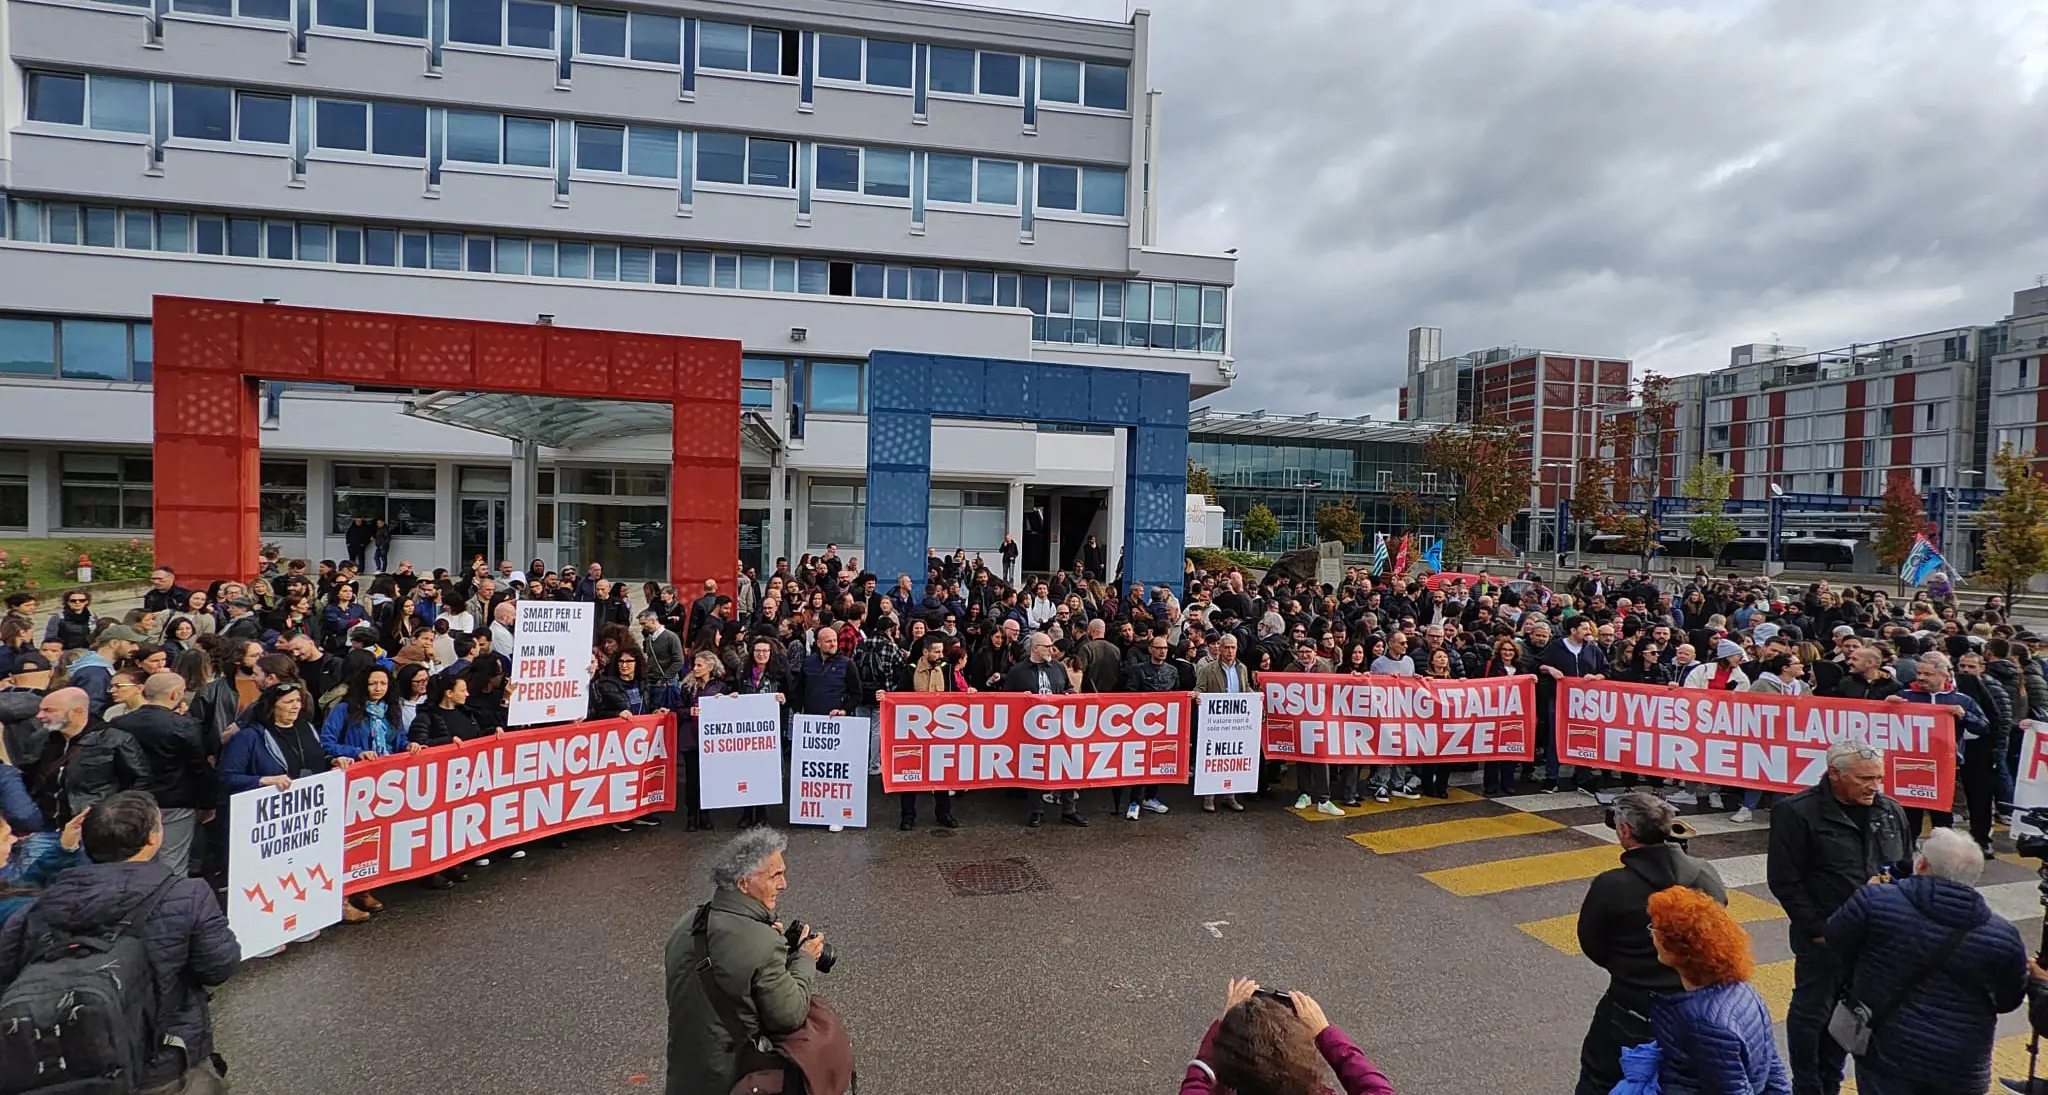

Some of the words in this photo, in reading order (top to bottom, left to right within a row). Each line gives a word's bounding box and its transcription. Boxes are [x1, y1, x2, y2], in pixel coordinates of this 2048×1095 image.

[523, 607, 554, 619] SMART
[555, 608, 571, 620] PER
[572, 608, 582, 620] LE
[522, 620, 571, 633] COLLEZIONI,
[520, 645, 535, 657] MA
[537, 645, 555, 657] NON
[519, 659, 546, 679] PER
[550, 658, 566, 677] LE
[517, 680, 582, 702] PERSONE.
[1208, 699, 1250, 716] KERING,
[1265, 682, 1326, 716] RSU
[1332, 683, 1435, 719] KERING
[1437, 684, 1525, 719] ITALIA
[703, 722, 734, 736] SENZA
[736, 720, 775, 734] DIALOGO
[803, 720, 812, 734] IL
[815, 721, 841, 735] VERO
[894, 703, 1009, 740] RSU
[1023, 702, 1180, 740] GUCCI
[1568, 687, 1618, 723] RSU
[1622, 692, 1691, 731] YVES
[1695, 699, 1781, 740] SAINT
[1786, 706, 1935, 753] LAURENT
[703, 739, 714, 754] SI
[718, 735, 777, 753] SCIOPERA!
[802, 736, 841, 751] LUSSO?
[1205, 739, 1212, 756] È
[1214, 741, 1243, 756] NELLE
[1301, 720, 1496, 757] FIRENZE
[929, 740, 1147, 782] FIRENZE
[1578, 751, 1596, 759] CGIL
[1604, 727, 1884, 793] FIRENZ
[801, 761, 850, 779] ESSERE
[1204, 757, 1252, 774] PERSONE!
[345, 761, 438, 827] RSU
[445, 725, 668, 803] BALENCIAGA
[647, 793, 663, 803] CGIL
[800, 781, 853, 800] RISPETT
[1910, 789, 1936, 798] CGIL
[255, 783, 325, 824] KERING
[800, 801, 825, 818] ATI.
[250, 823, 277, 844] OLD
[281, 812, 310, 836] WAY
[313, 807, 329, 825] OF
[389, 770, 639, 872] FIRENZE
[260, 828, 320, 860] WORKING
[351, 866, 378, 879] CGIL
